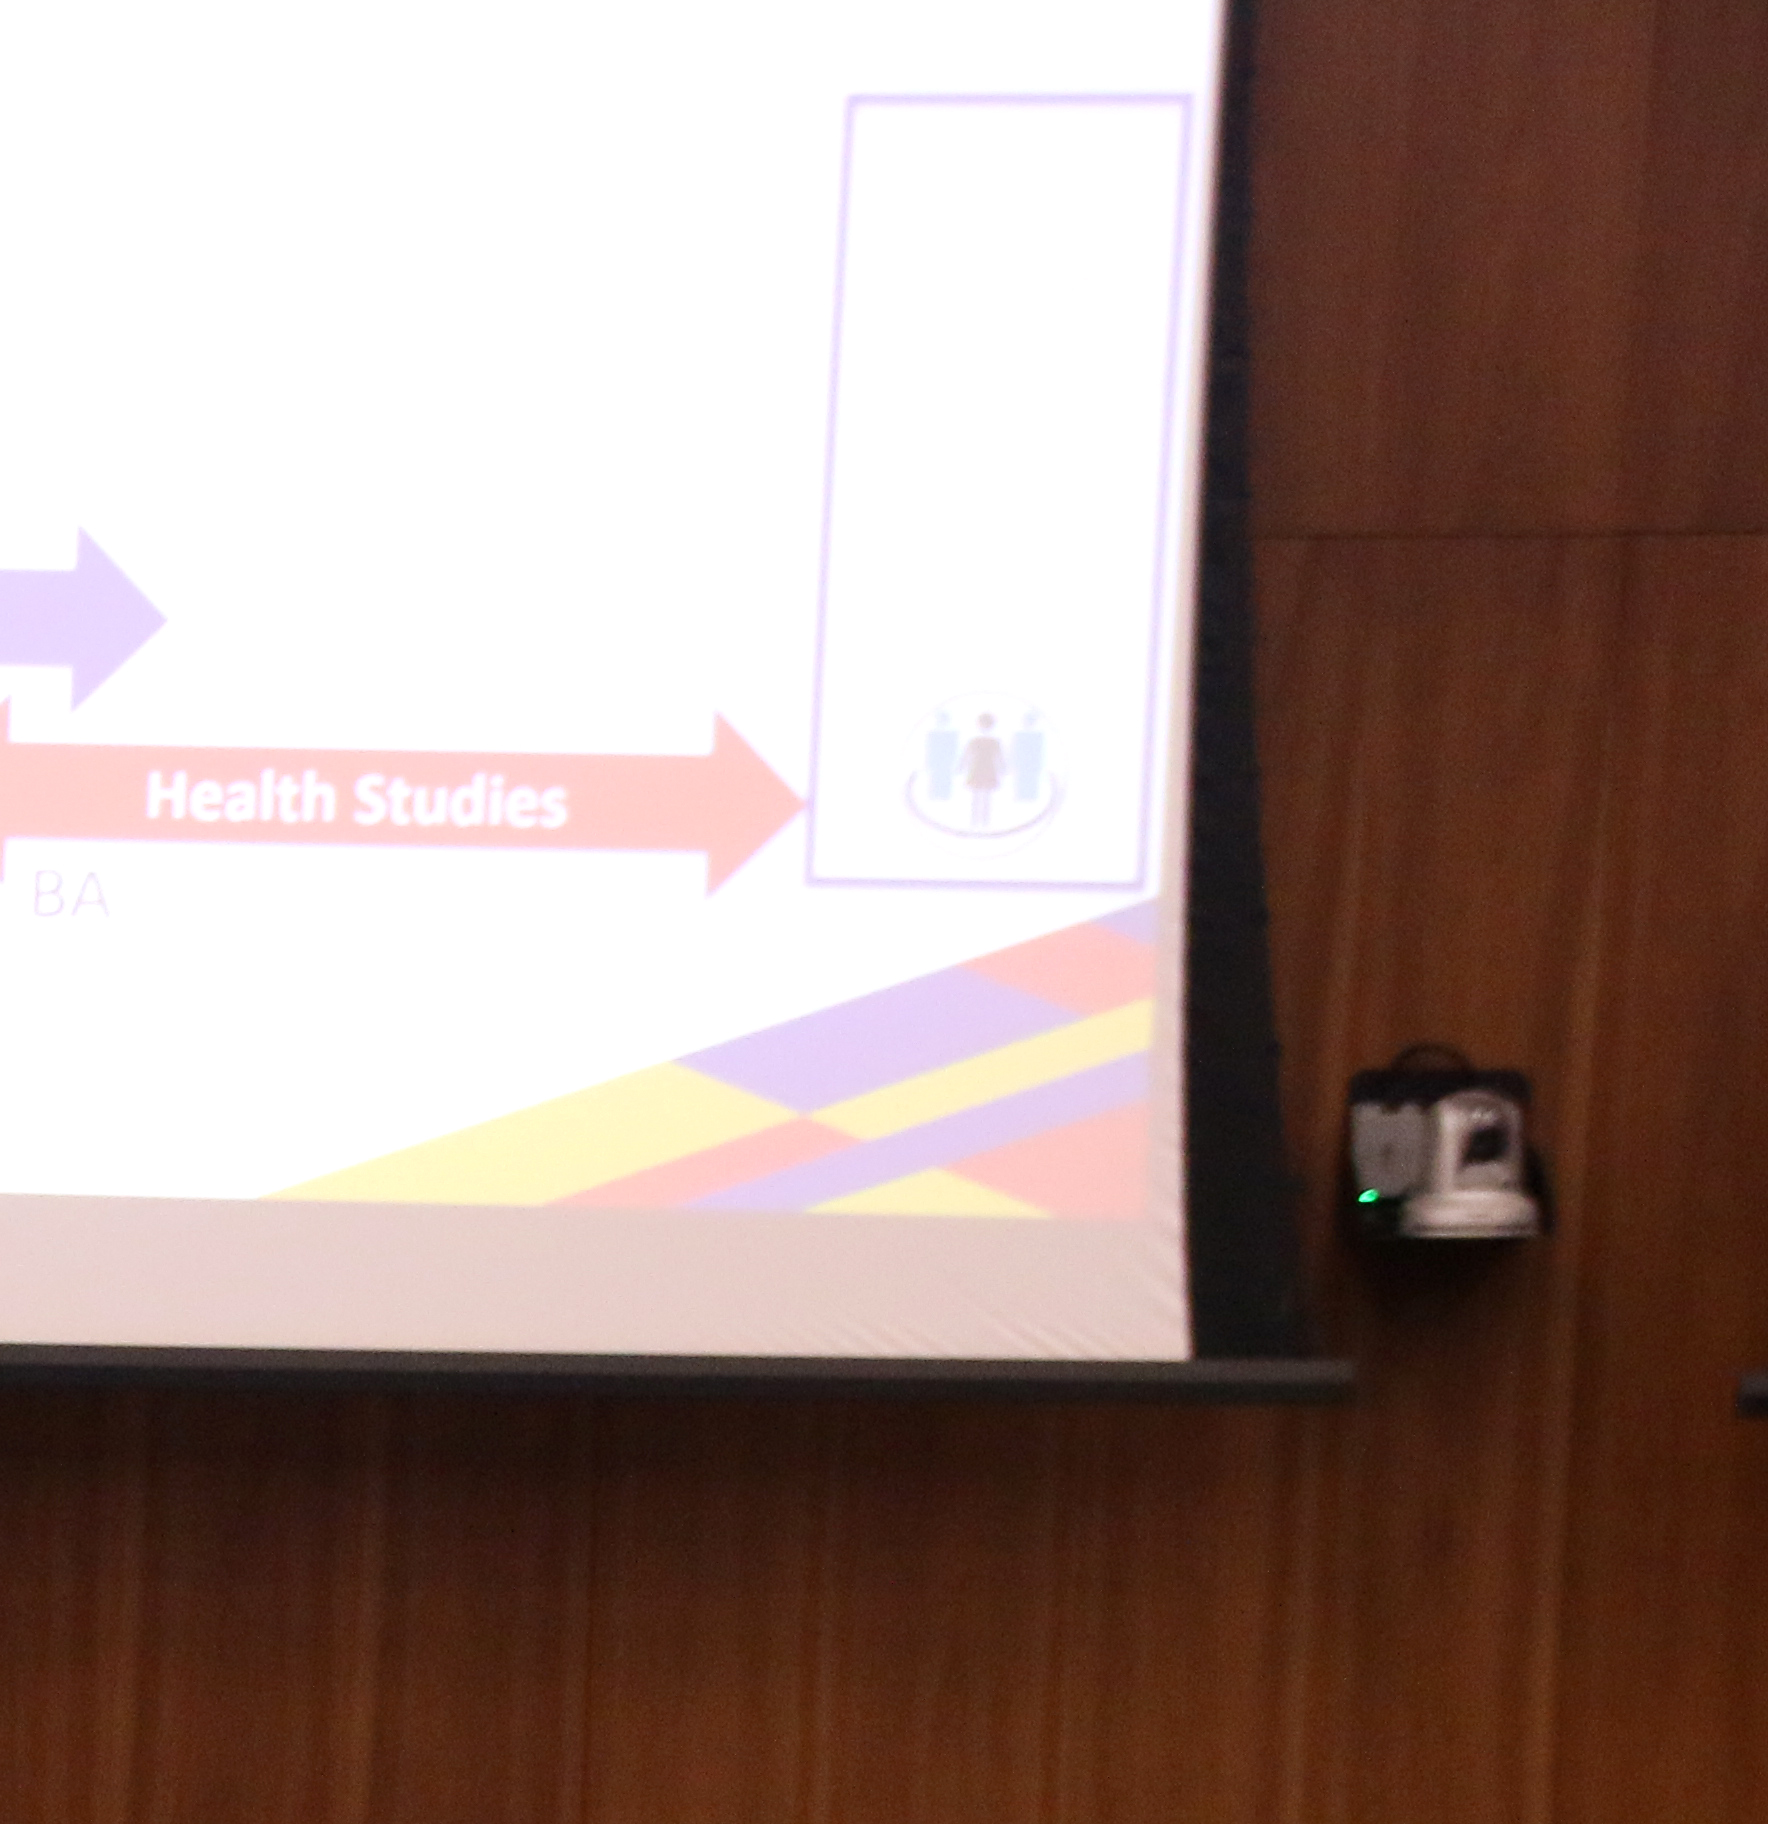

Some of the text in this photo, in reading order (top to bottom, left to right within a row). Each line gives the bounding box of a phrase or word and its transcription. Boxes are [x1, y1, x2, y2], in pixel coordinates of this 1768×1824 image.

[145, 767, 569, 831] Health Studies
[31, 868, 111, 918] BA
